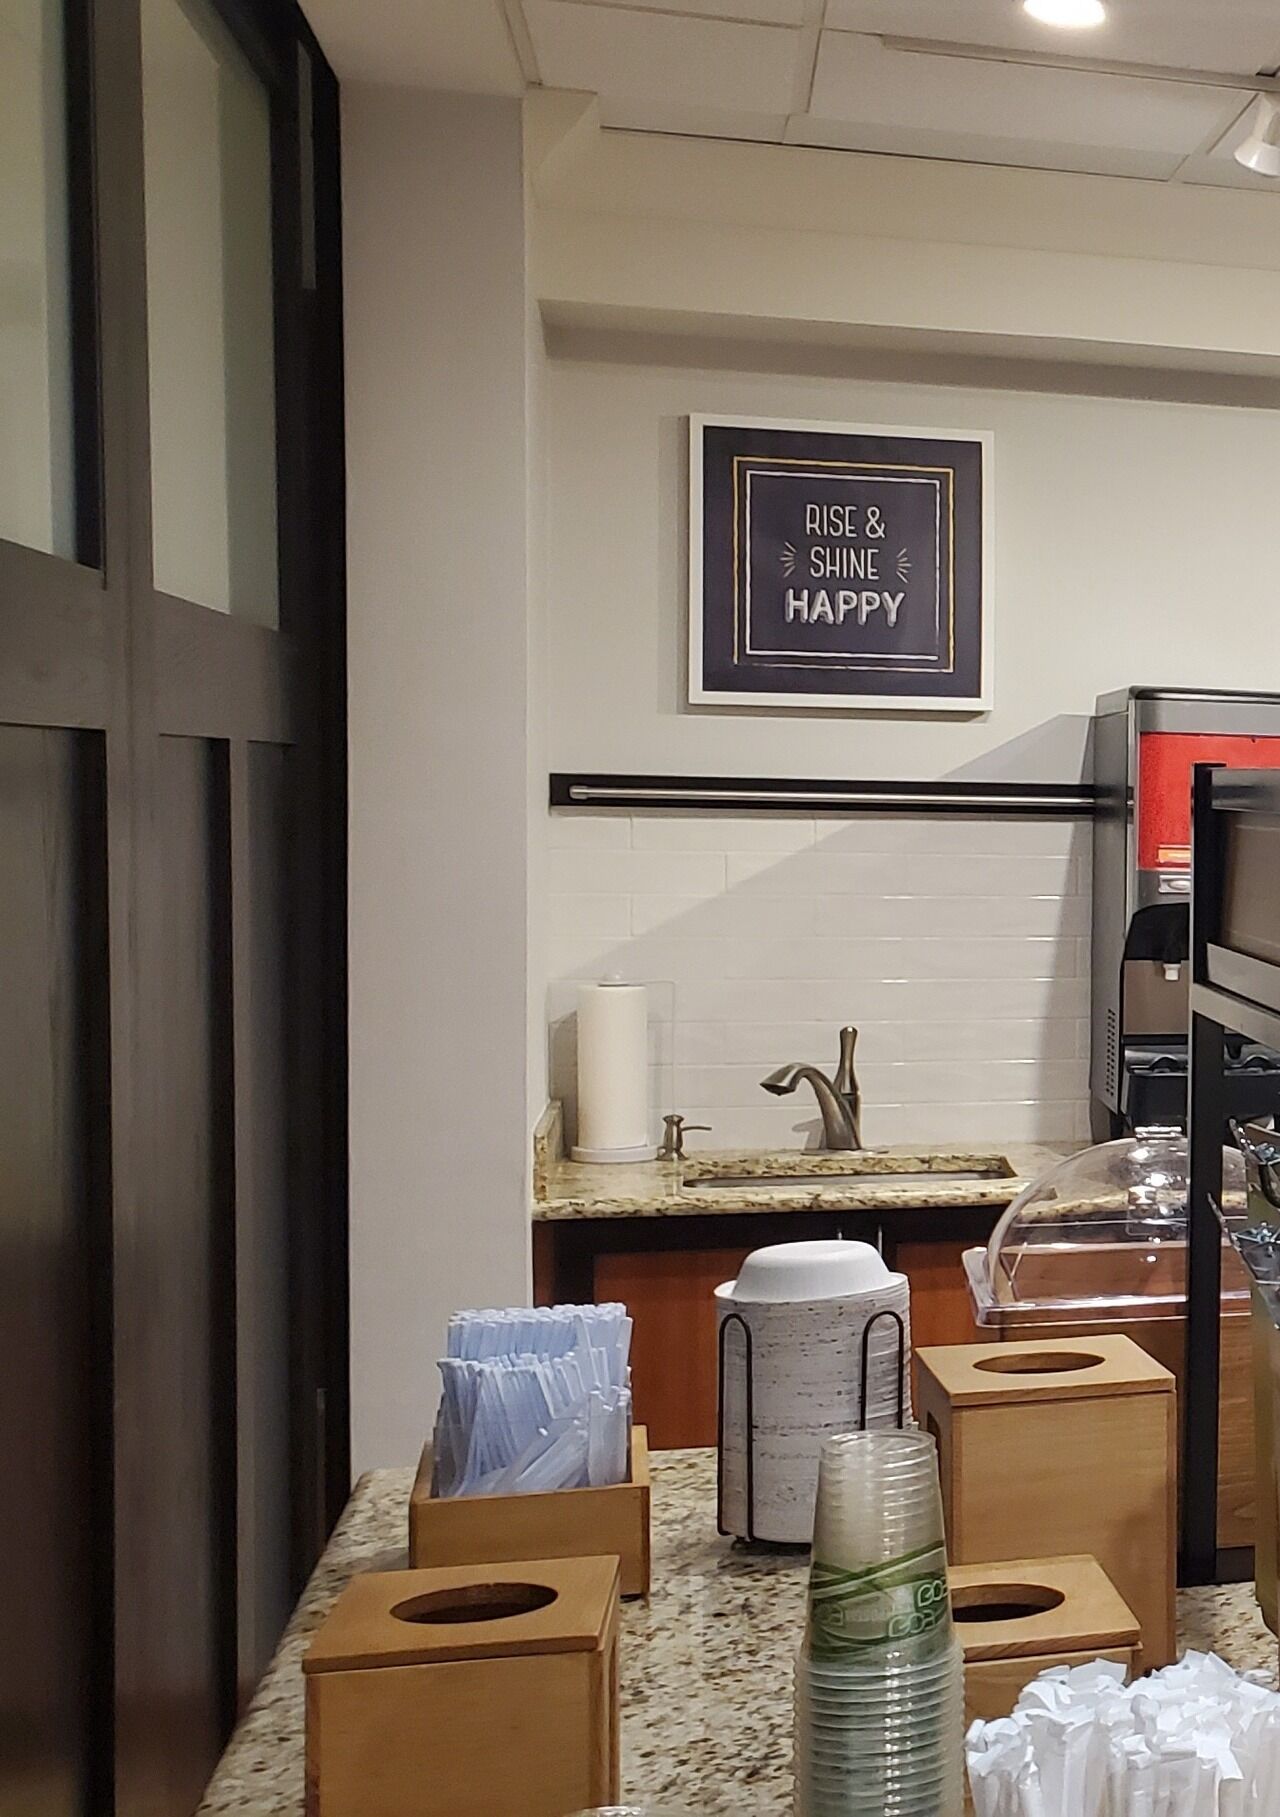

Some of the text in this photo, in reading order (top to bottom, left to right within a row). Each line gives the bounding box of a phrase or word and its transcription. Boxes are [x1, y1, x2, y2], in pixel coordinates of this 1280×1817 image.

[805, 504, 886, 538] RISE &
[810, 546, 880, 580] SHINE
[784, 588, 905, 627] HAPPY
